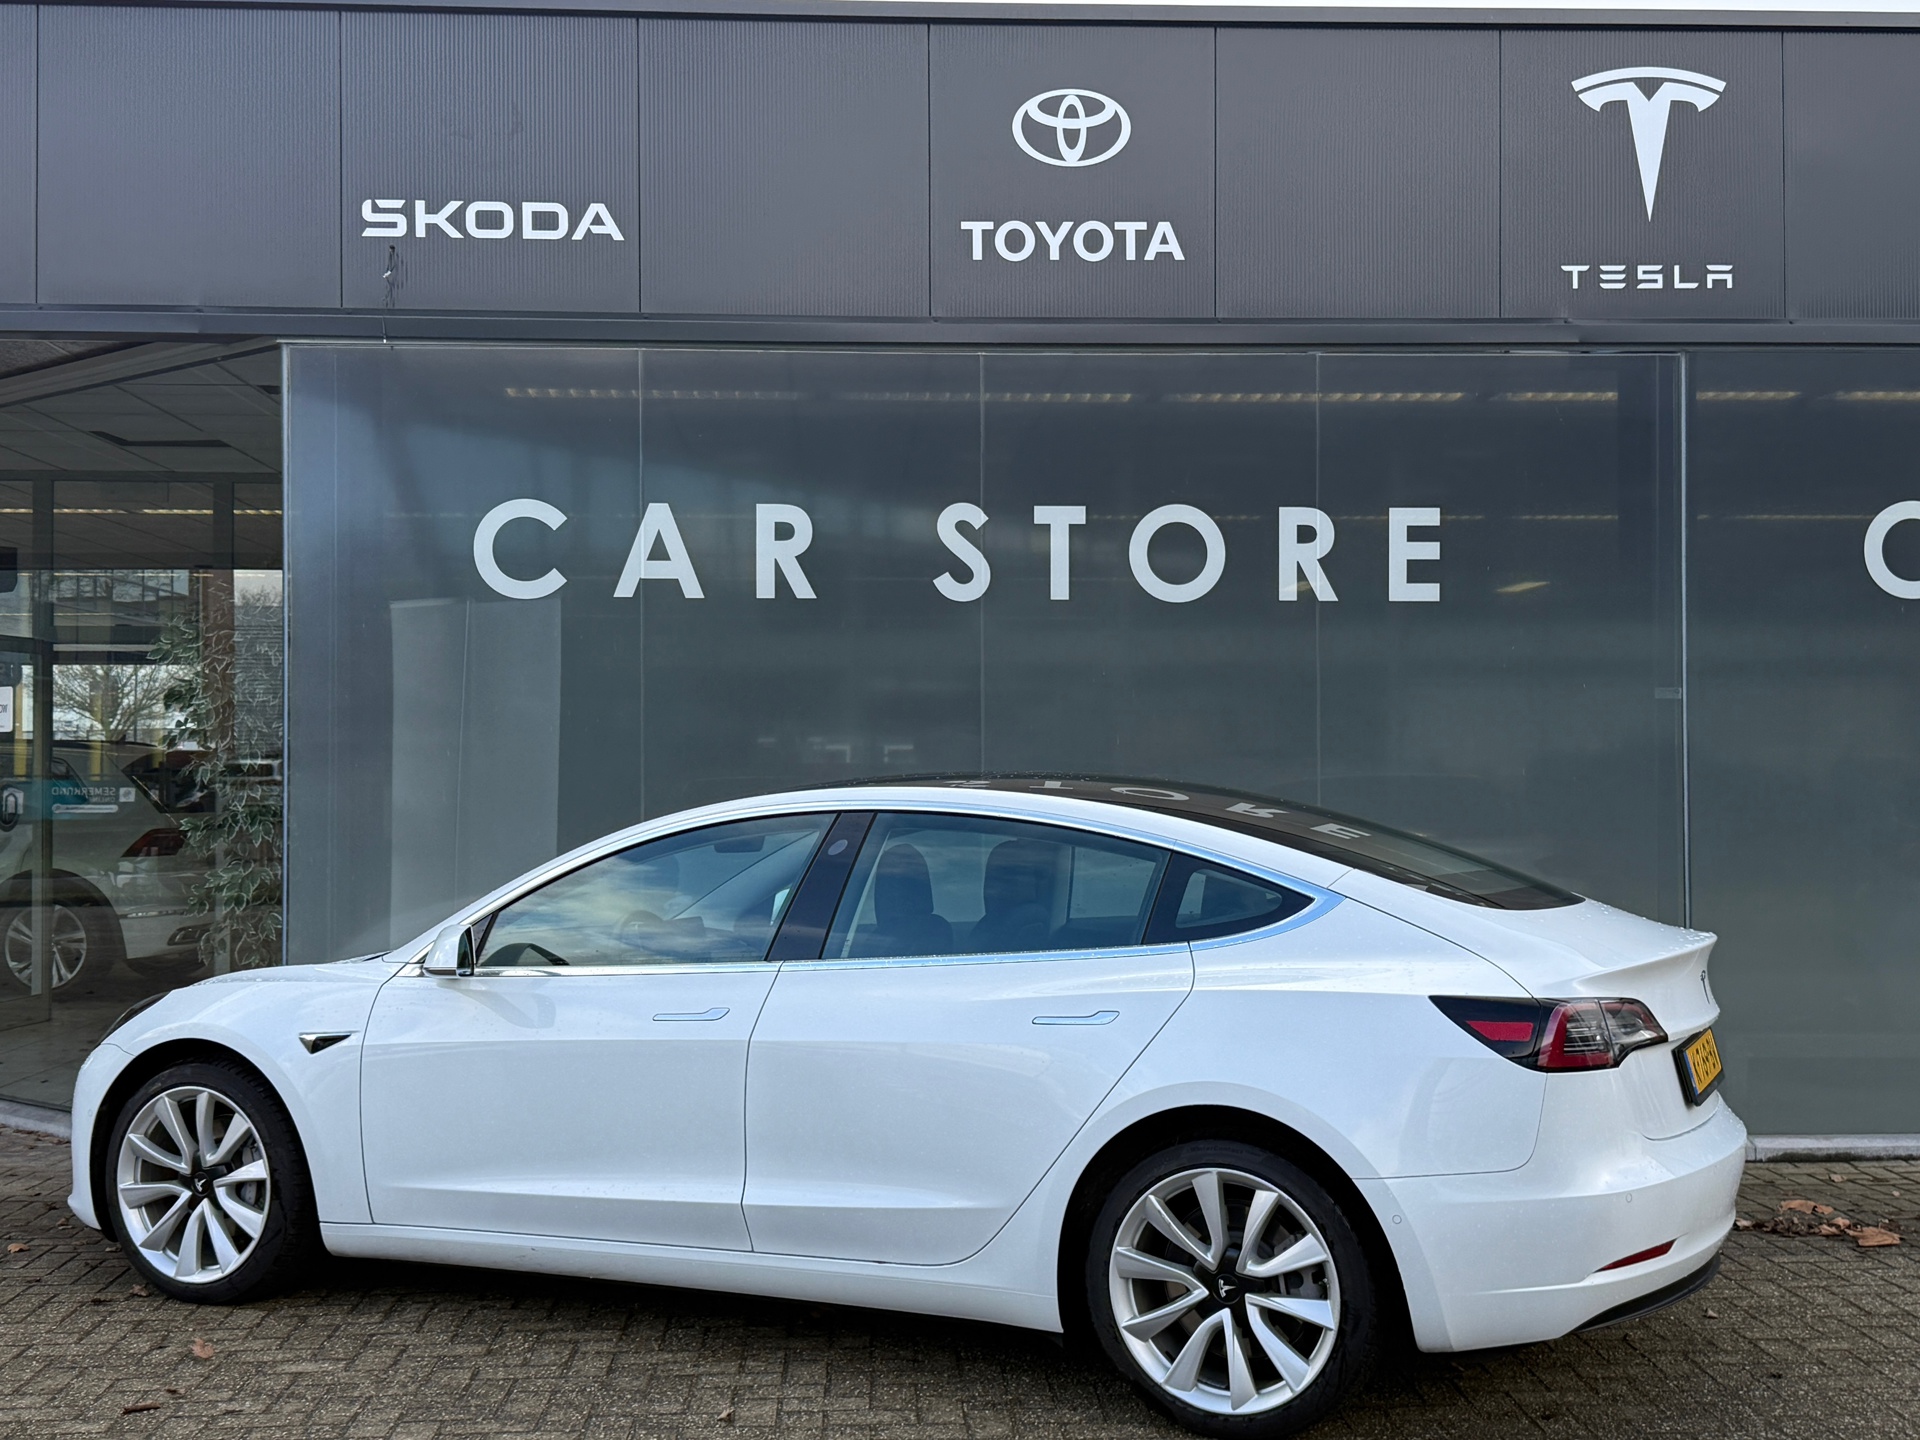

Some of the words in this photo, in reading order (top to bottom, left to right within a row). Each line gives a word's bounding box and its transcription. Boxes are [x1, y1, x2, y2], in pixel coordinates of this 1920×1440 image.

[960, 220, 1185, 262] TOYOTA
[1560, 264, 1733, 289] TESLA
[473, 498, 817, 600] CAR
[932, 502, 1441, 603] STORE
